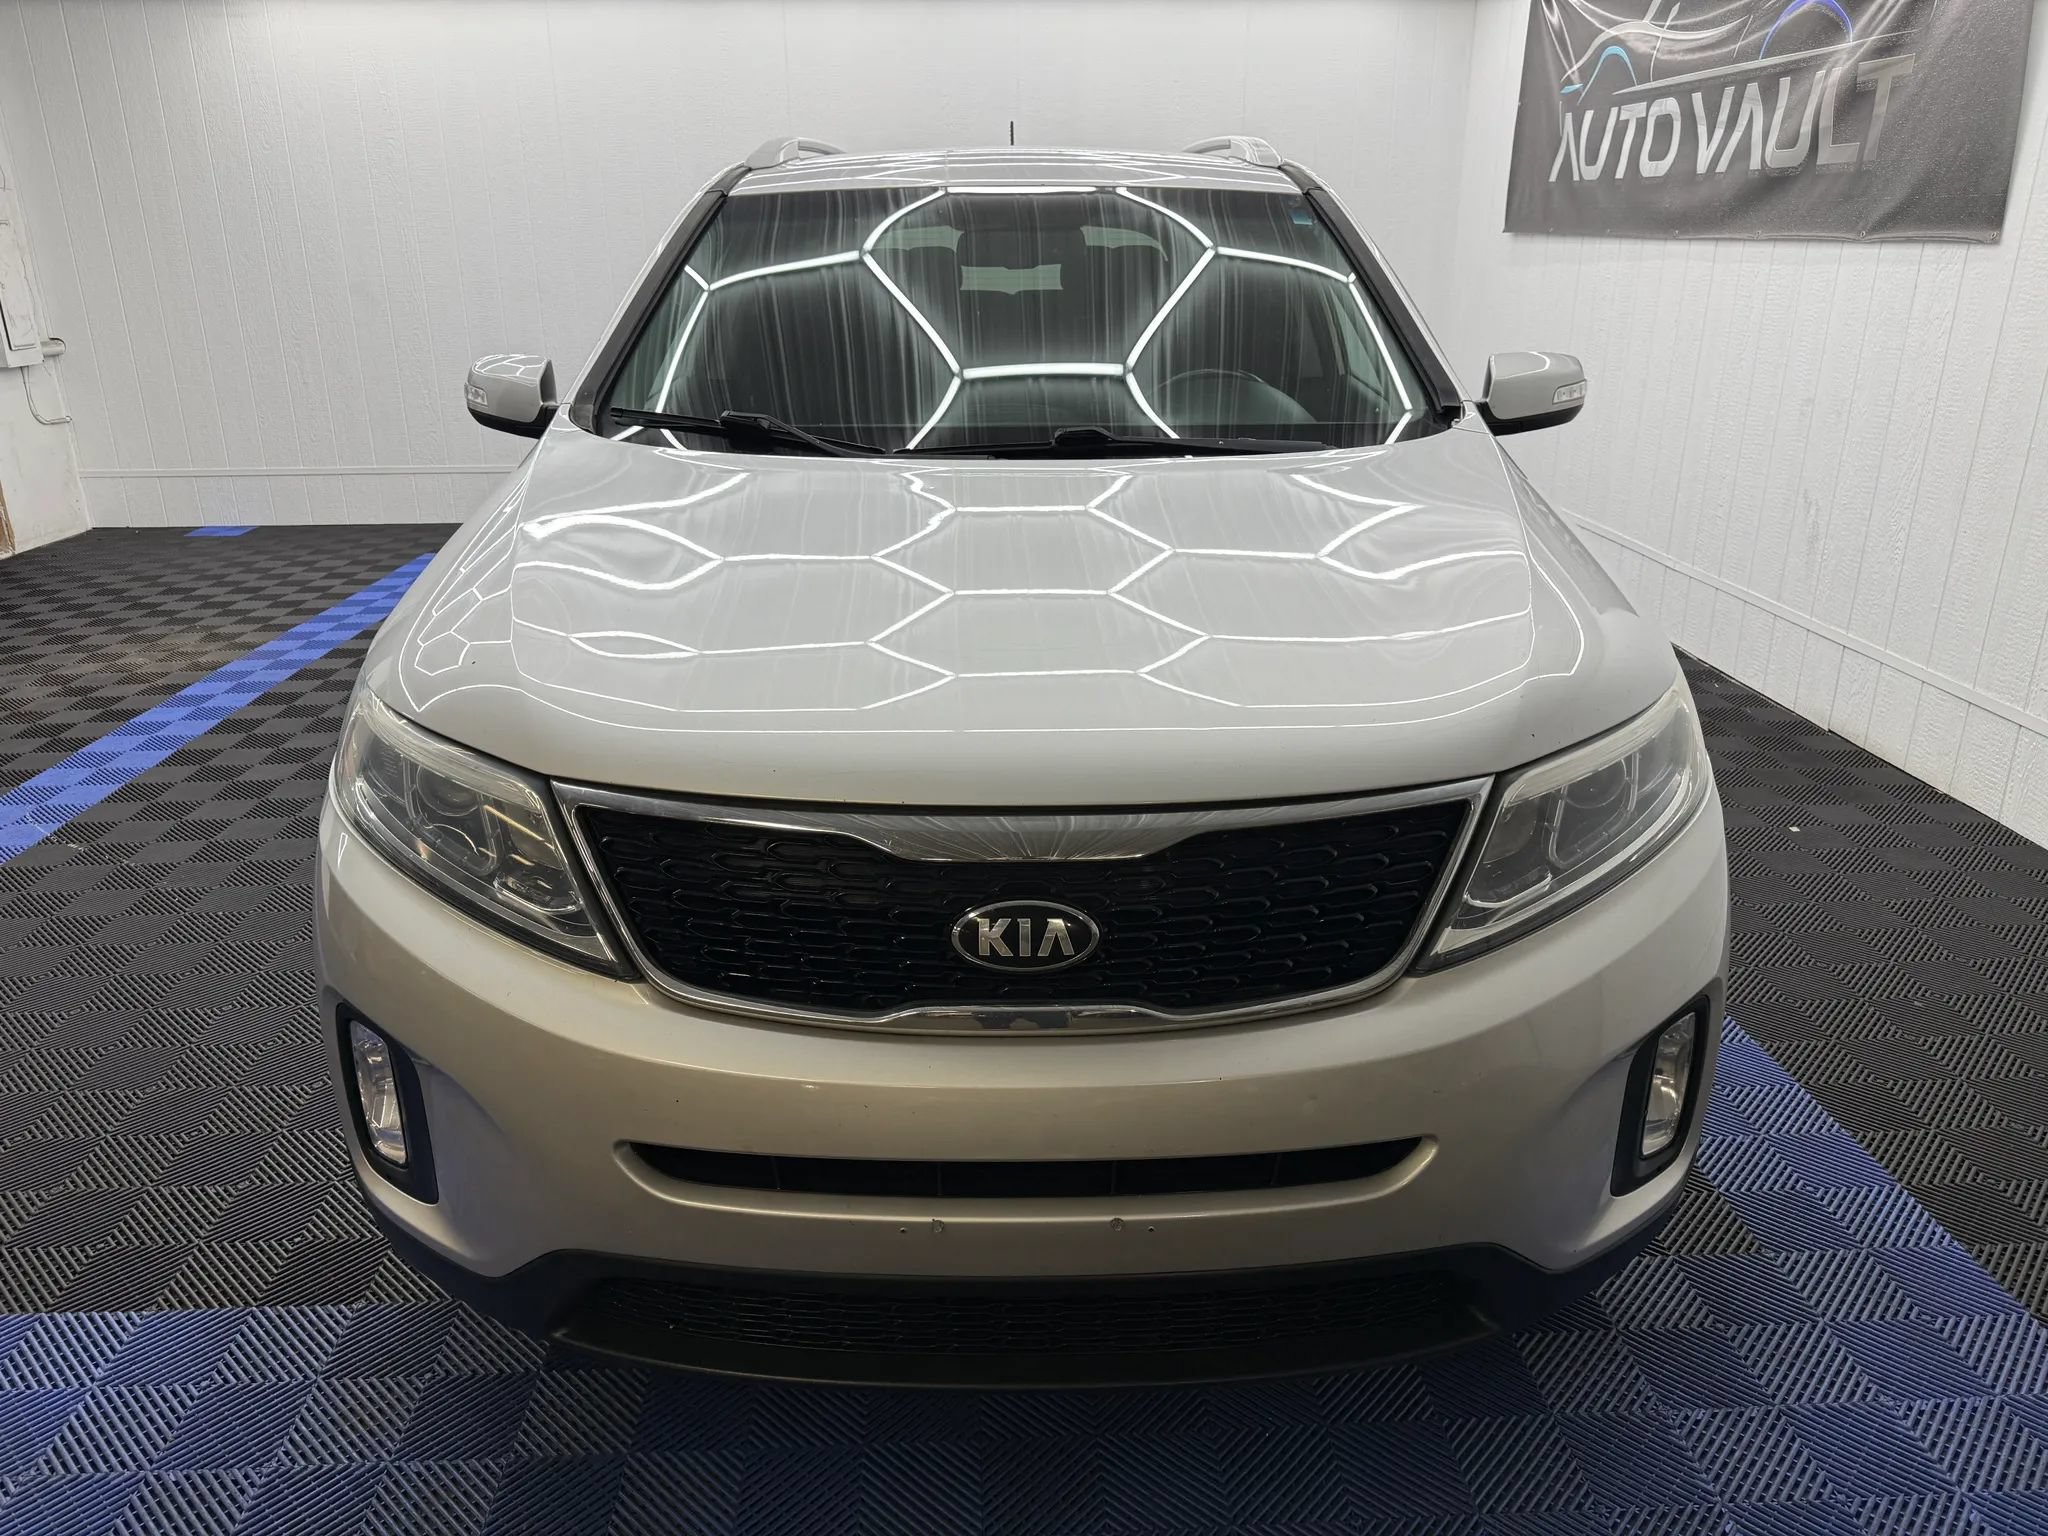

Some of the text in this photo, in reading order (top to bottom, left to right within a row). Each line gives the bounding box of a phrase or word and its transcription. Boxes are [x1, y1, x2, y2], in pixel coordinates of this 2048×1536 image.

[1548, 53, 1916, 183] AUTO VAULT
[977, 918, 1075, 957] KIA
